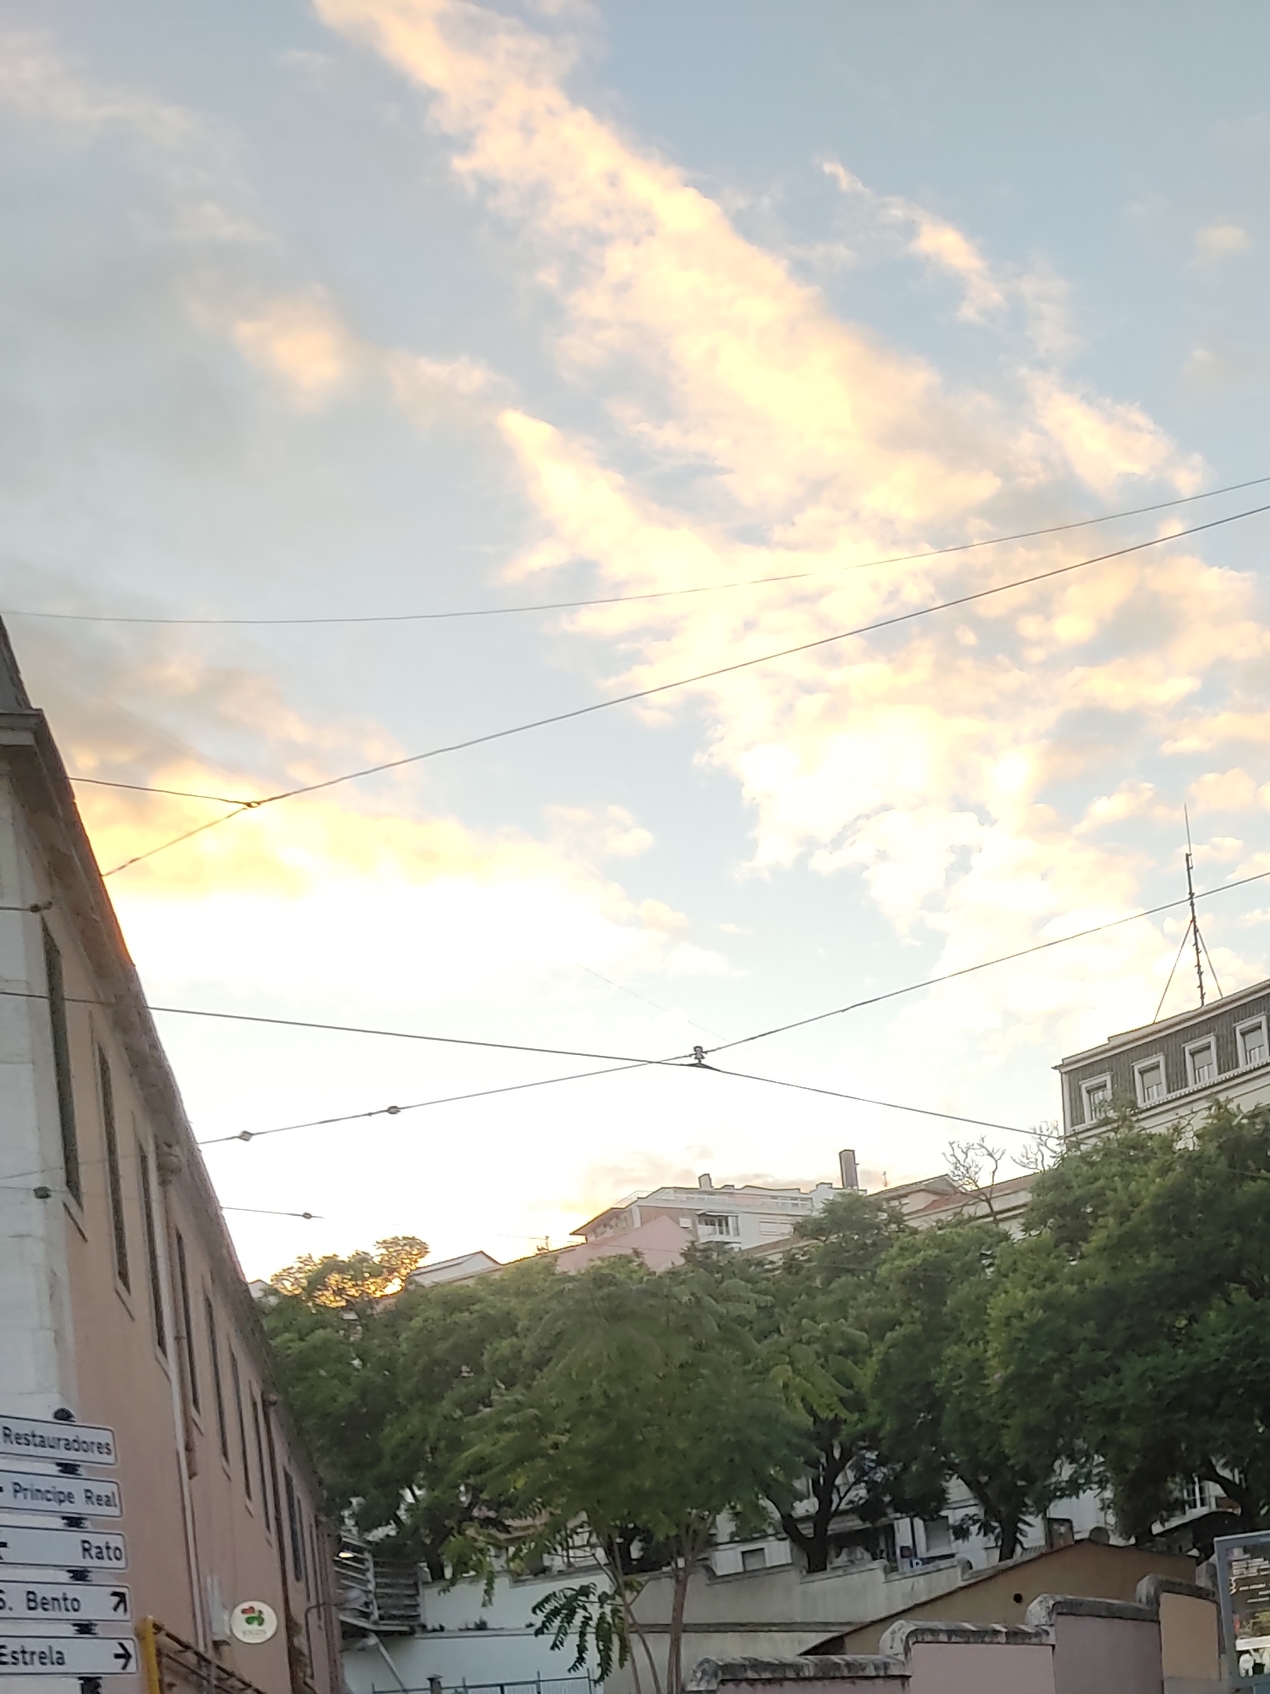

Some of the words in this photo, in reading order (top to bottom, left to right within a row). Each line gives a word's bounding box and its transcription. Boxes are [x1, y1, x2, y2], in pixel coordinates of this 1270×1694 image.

[2, 1426, 112, 1455] Restauradores
[83, 1488, 118, 1508] Real
[80, 1539, 123, 1561] Rato
[25, 1590, 82, 1612] Bento
[0, 1645, 66, 1666] Estrela
